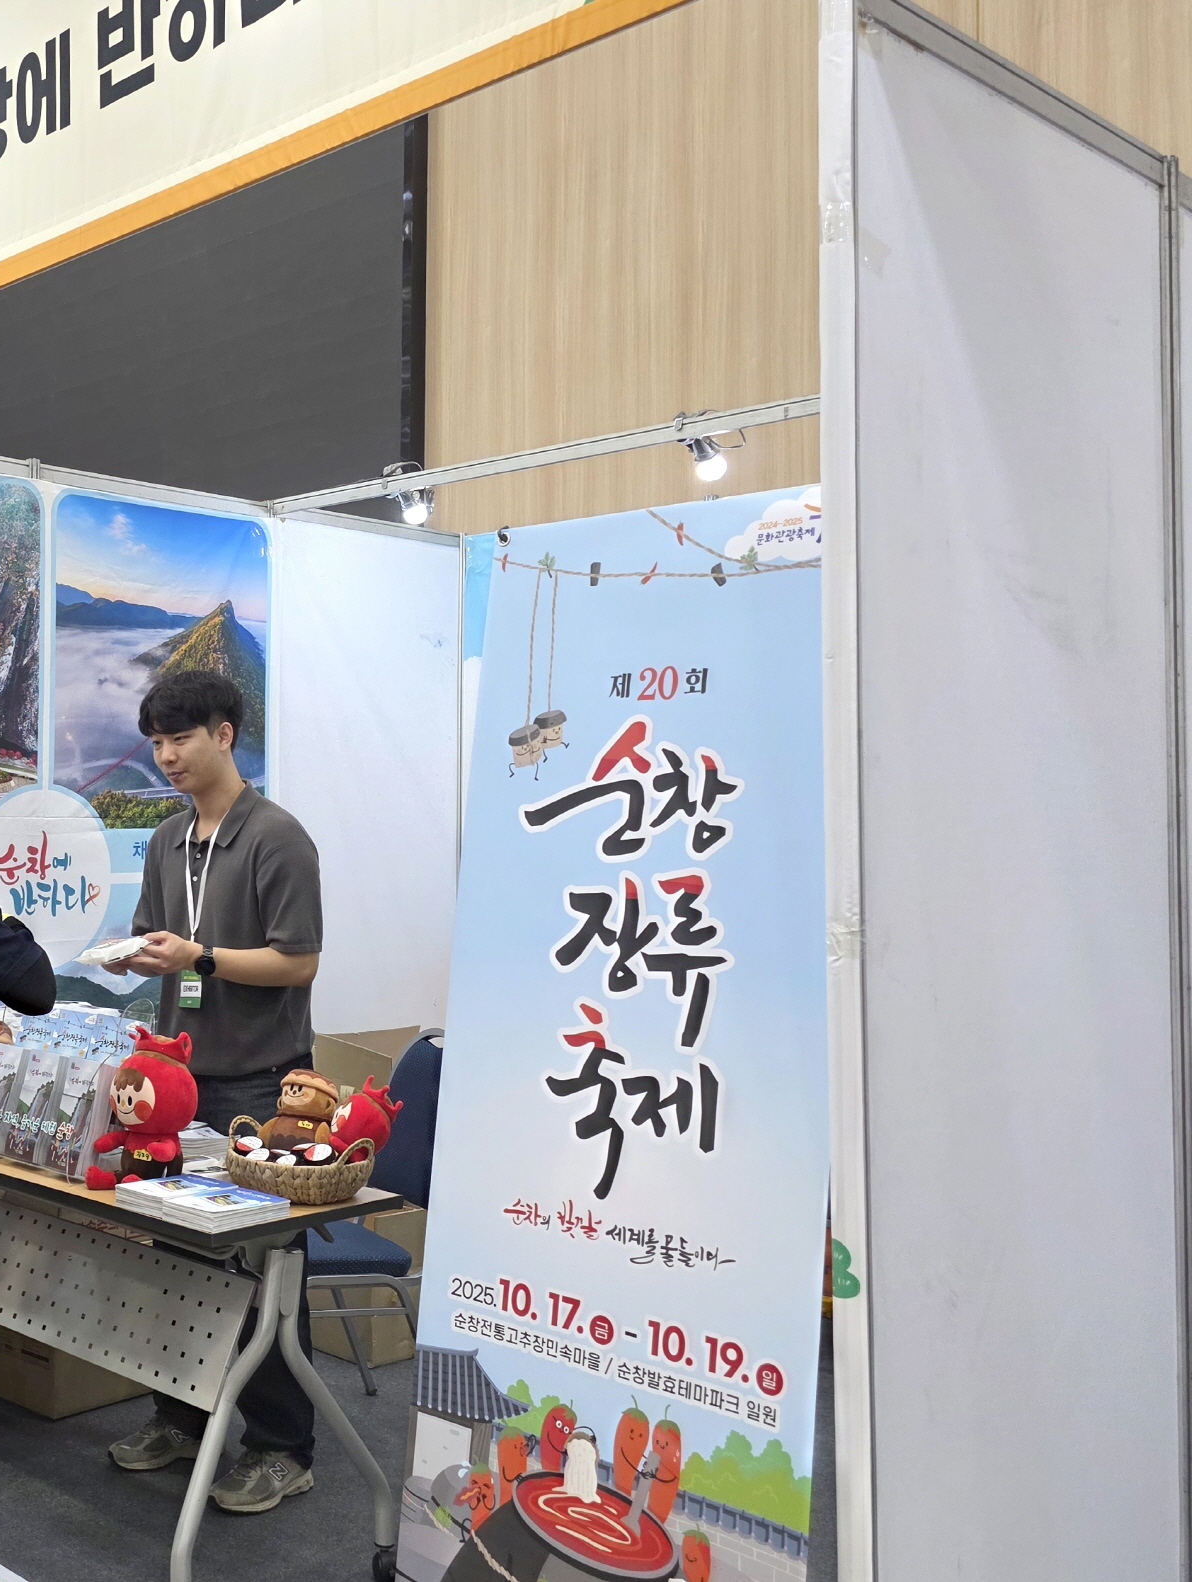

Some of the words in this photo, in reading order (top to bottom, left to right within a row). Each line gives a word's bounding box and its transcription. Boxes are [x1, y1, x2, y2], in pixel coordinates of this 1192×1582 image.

[98, 0, 301, 109] 반하
[756, 527, 815, 546] 문화관광축제
[758, 517, 803, 530] 2024-2025
[522, 719, 739, 856] 순창
[9, 875, 87, 917] 반하다
[553, 872, 729, 1049] 장류
[56, 1121, 75, 1140] 순창
[544, 1002, 722, 1200] 축제
[503, 1198, 551, 1230] 순창의
[605, 1224, 659, 1264] 세계를
[660, 1234, 736, 1271] 물들이다
[454, 1313, 601, 1371] 순창전통고추장민속마을
[617, 1362, 740, 1415] 순창발효테마파크
[746, 1400, 778, 1427] 일원
